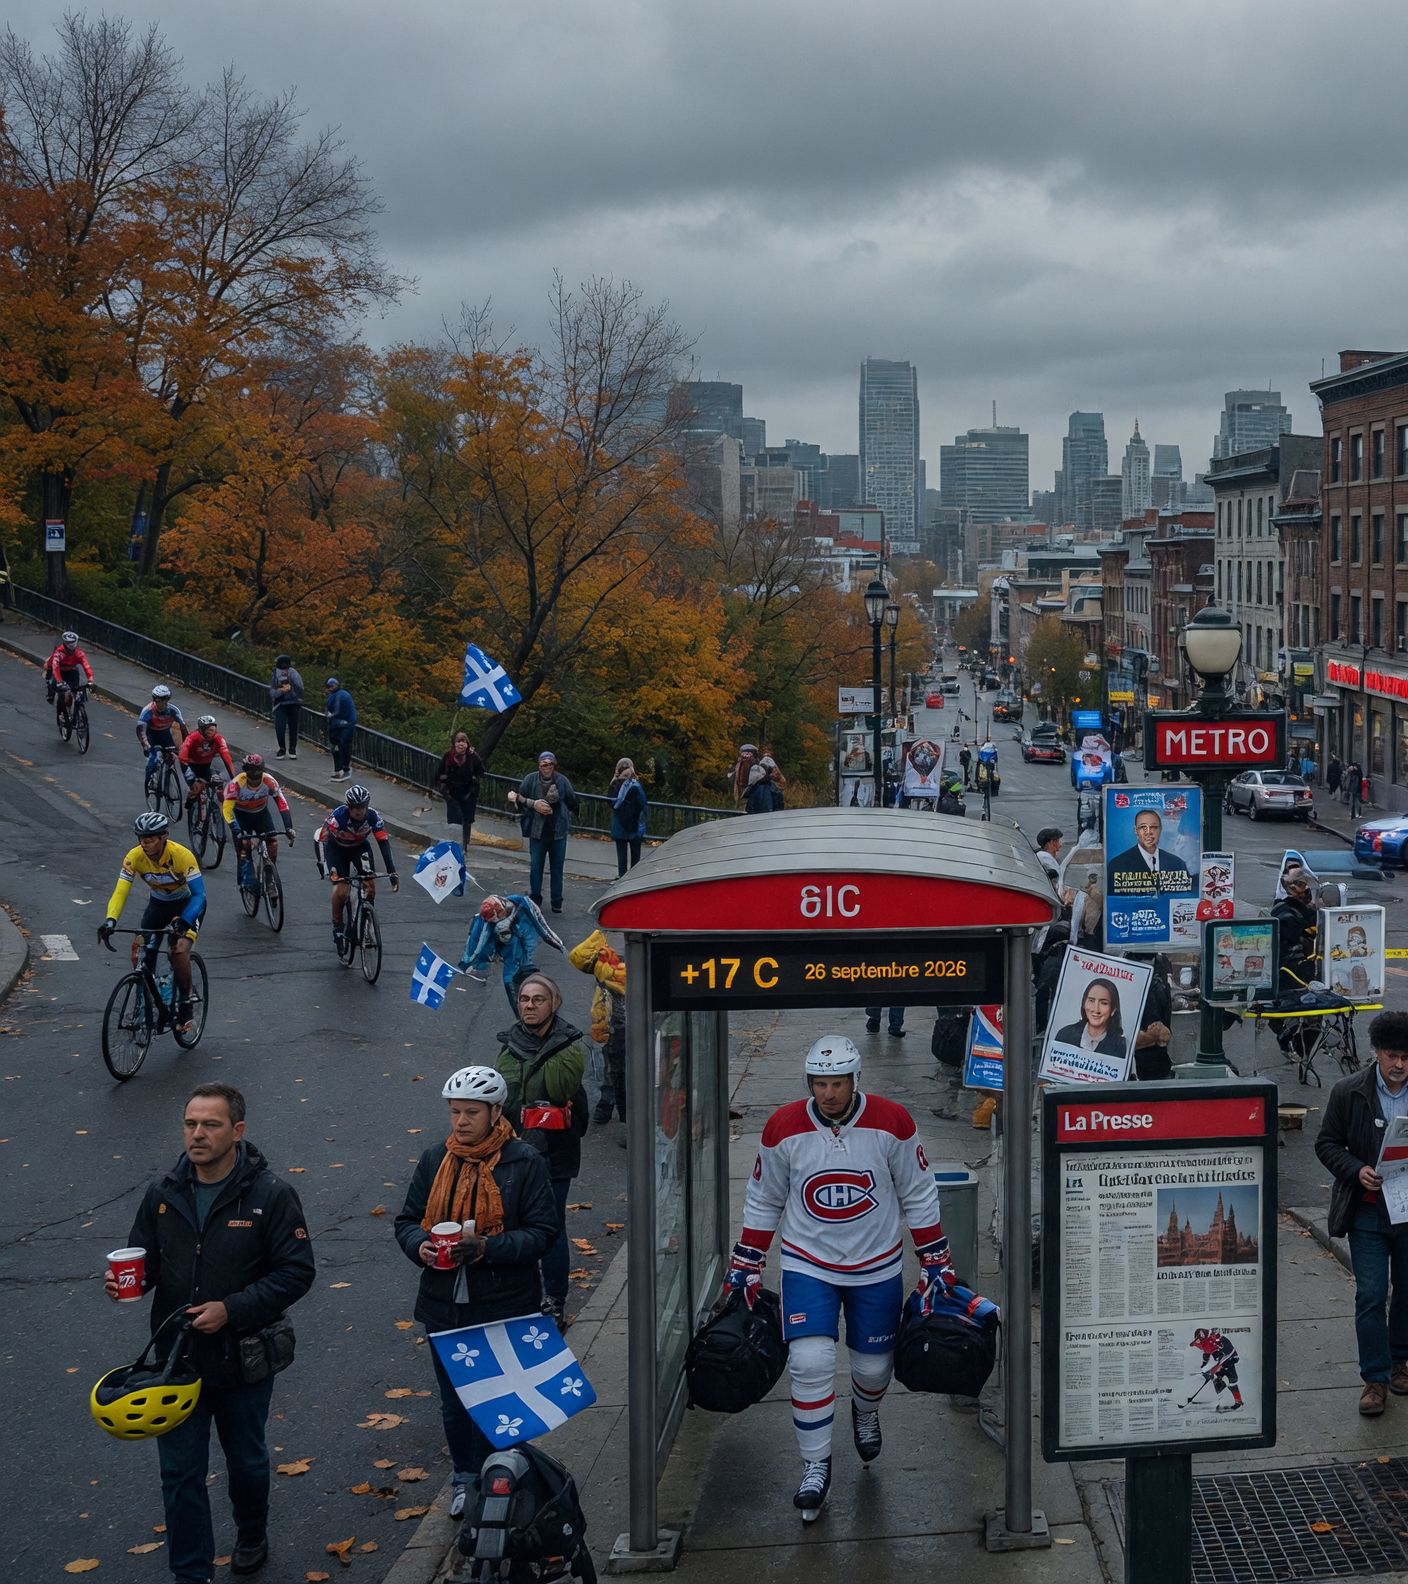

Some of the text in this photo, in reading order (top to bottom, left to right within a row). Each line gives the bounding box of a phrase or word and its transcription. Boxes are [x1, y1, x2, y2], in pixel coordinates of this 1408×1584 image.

[1165, 727, 1270, 756] METRO
[680, 956, 967, 990] +17 C 26 septembre 2026
[1064, 1110, 1153, 1131] La Presse
